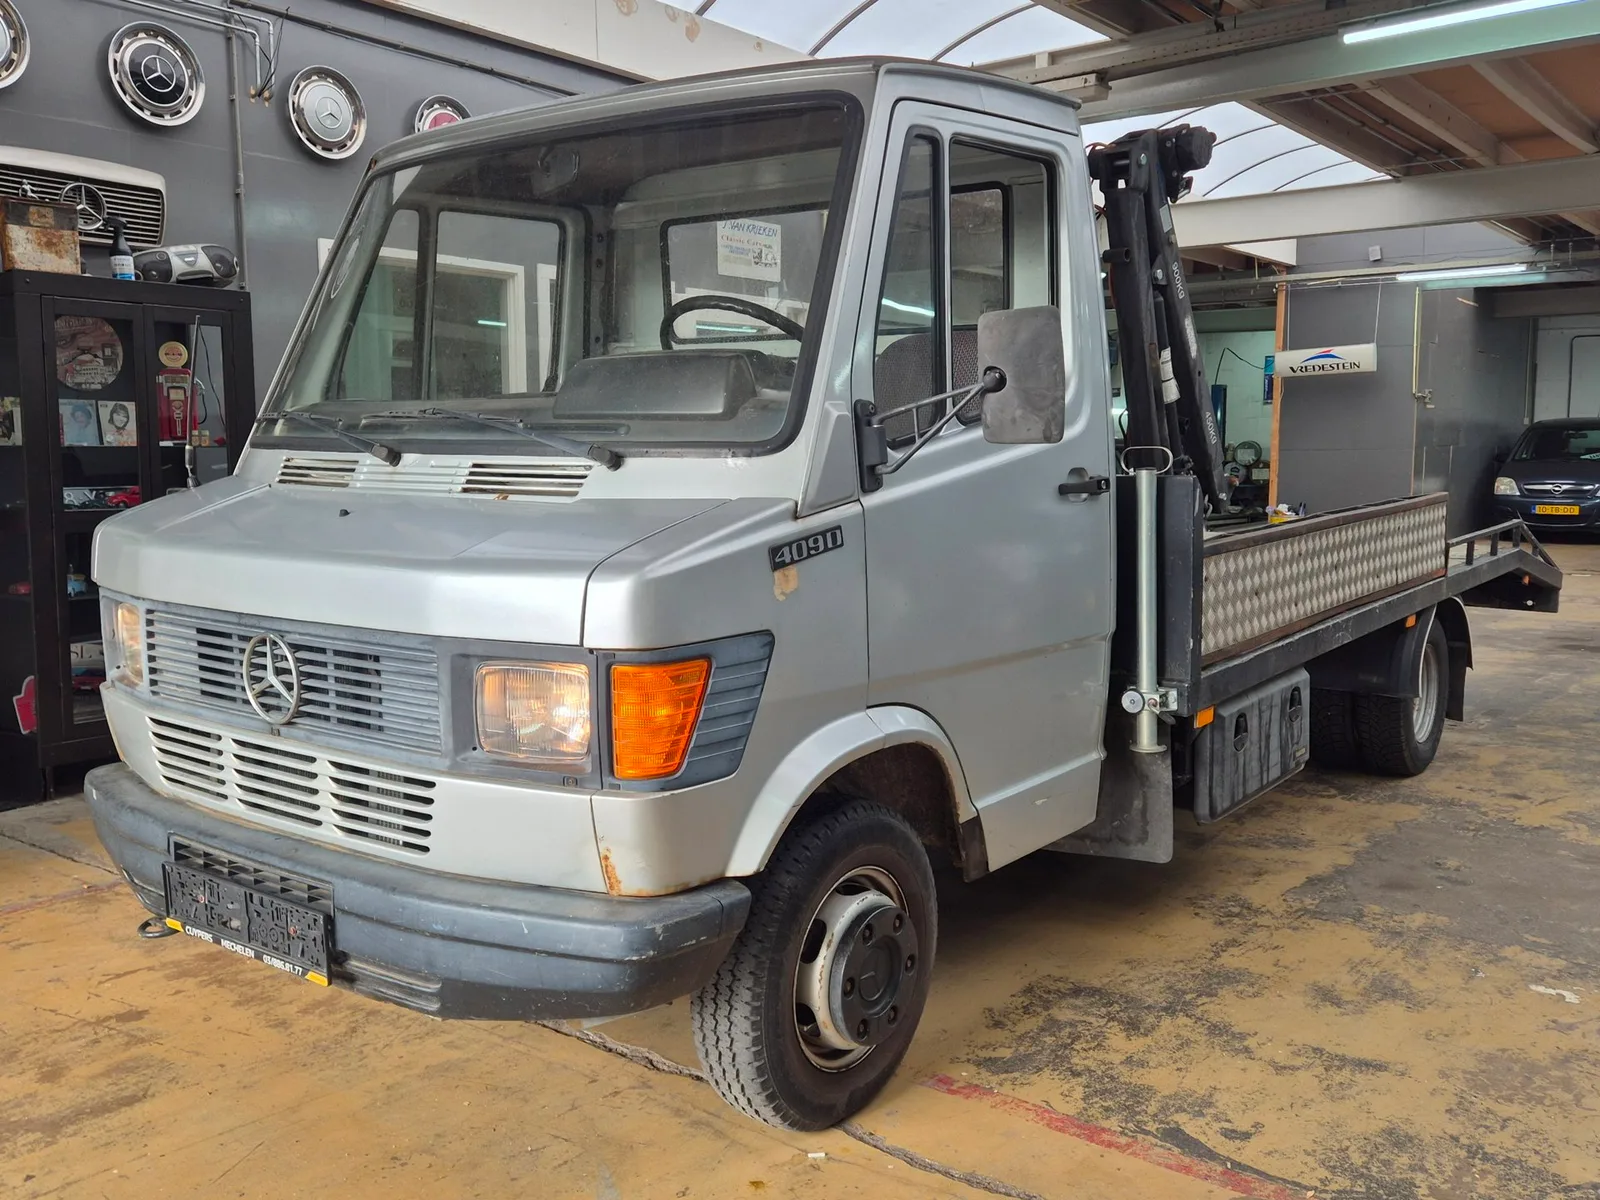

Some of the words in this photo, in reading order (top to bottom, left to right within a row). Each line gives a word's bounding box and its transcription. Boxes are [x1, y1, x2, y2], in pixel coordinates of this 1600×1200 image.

[1289, 361, 1361, 374] VREDESTEIN
[185, 925, 213, 943] CUYPERS
[220, 938, 255, 959] MECHELEN
